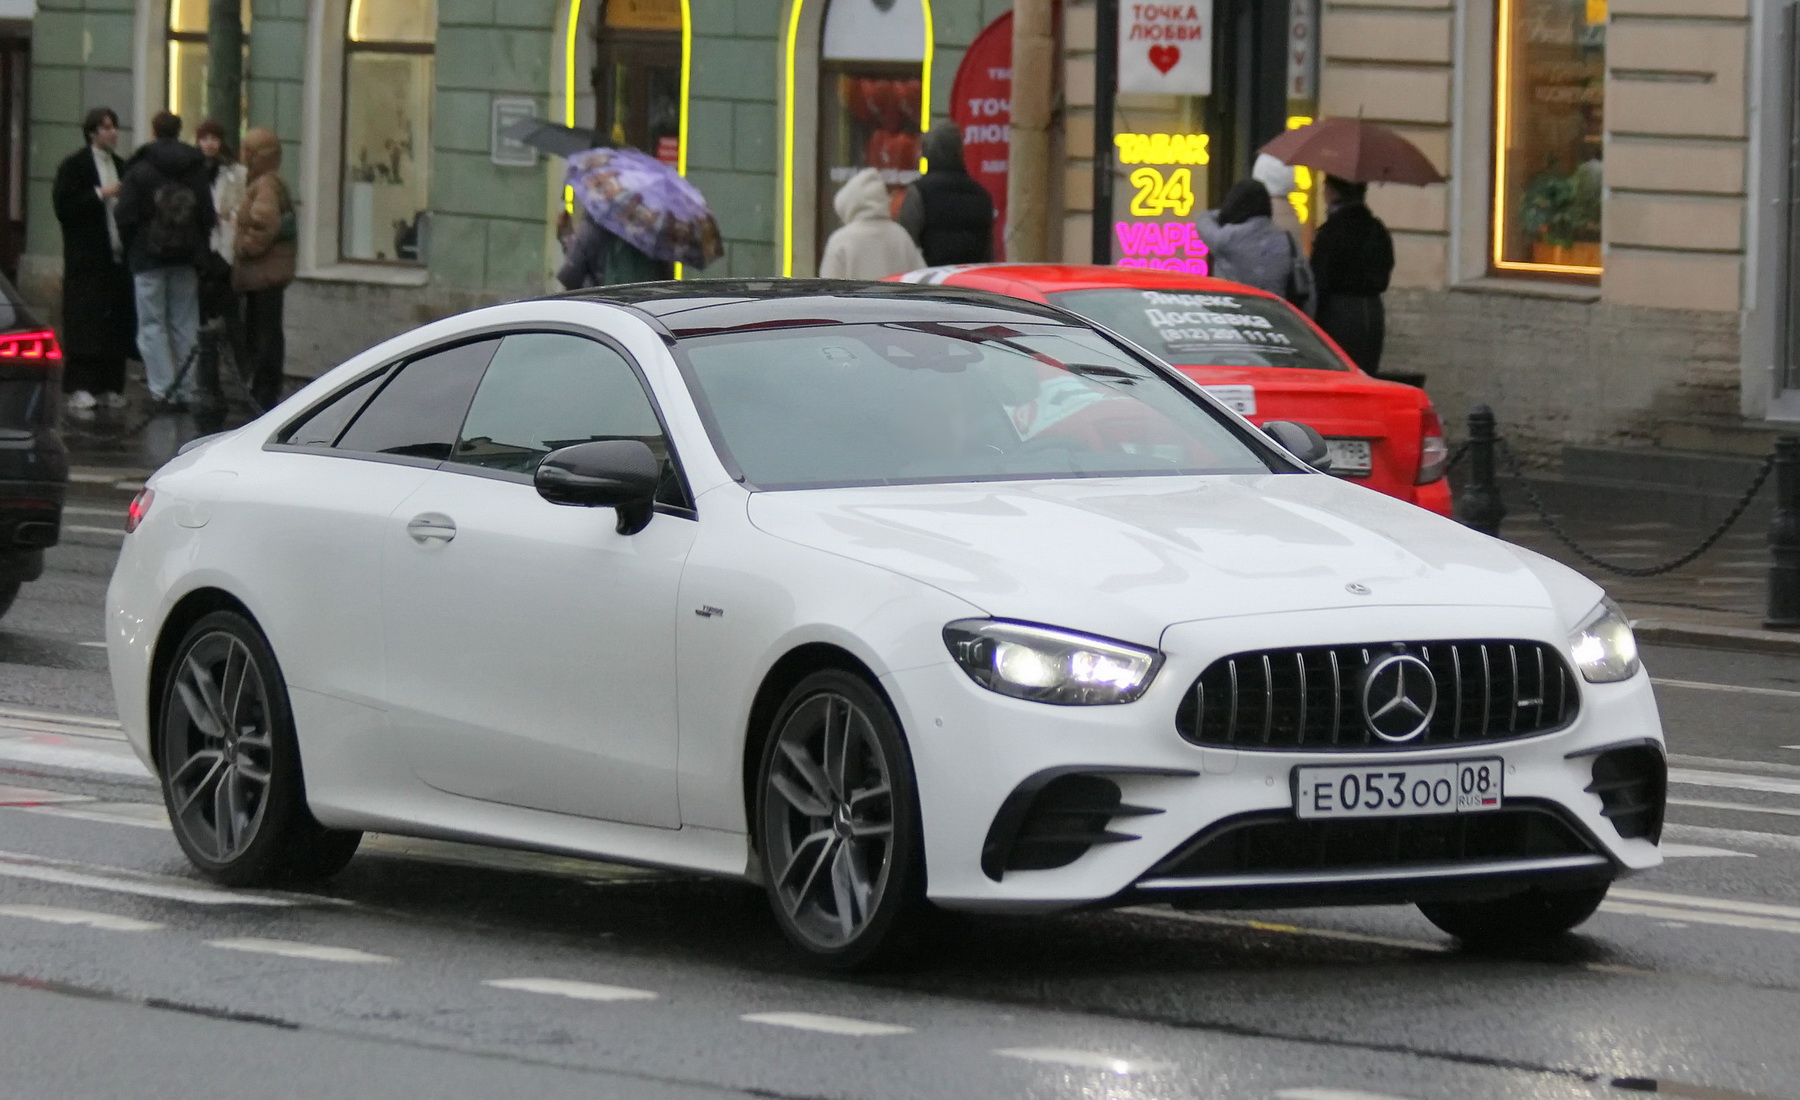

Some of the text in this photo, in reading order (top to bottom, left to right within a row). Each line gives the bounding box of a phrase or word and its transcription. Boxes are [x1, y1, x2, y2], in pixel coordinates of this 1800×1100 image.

[1133, 5, 1198, 20] ТОЧКА
[1129, 25, 1203, 41] ЛЮБВИ
[1113, 133, 1210, 165] ТАБАК
[1130, 168, 1194, 217] 24
[1115, 221, 1209, 257] VAPE
[1141, 290, 1242, 309] Яндекс
[1144, 308, 1274, 330] Доставка
[1461, 766, 1490, 794] 08
[1458, 795, 1482, 807] RUS
